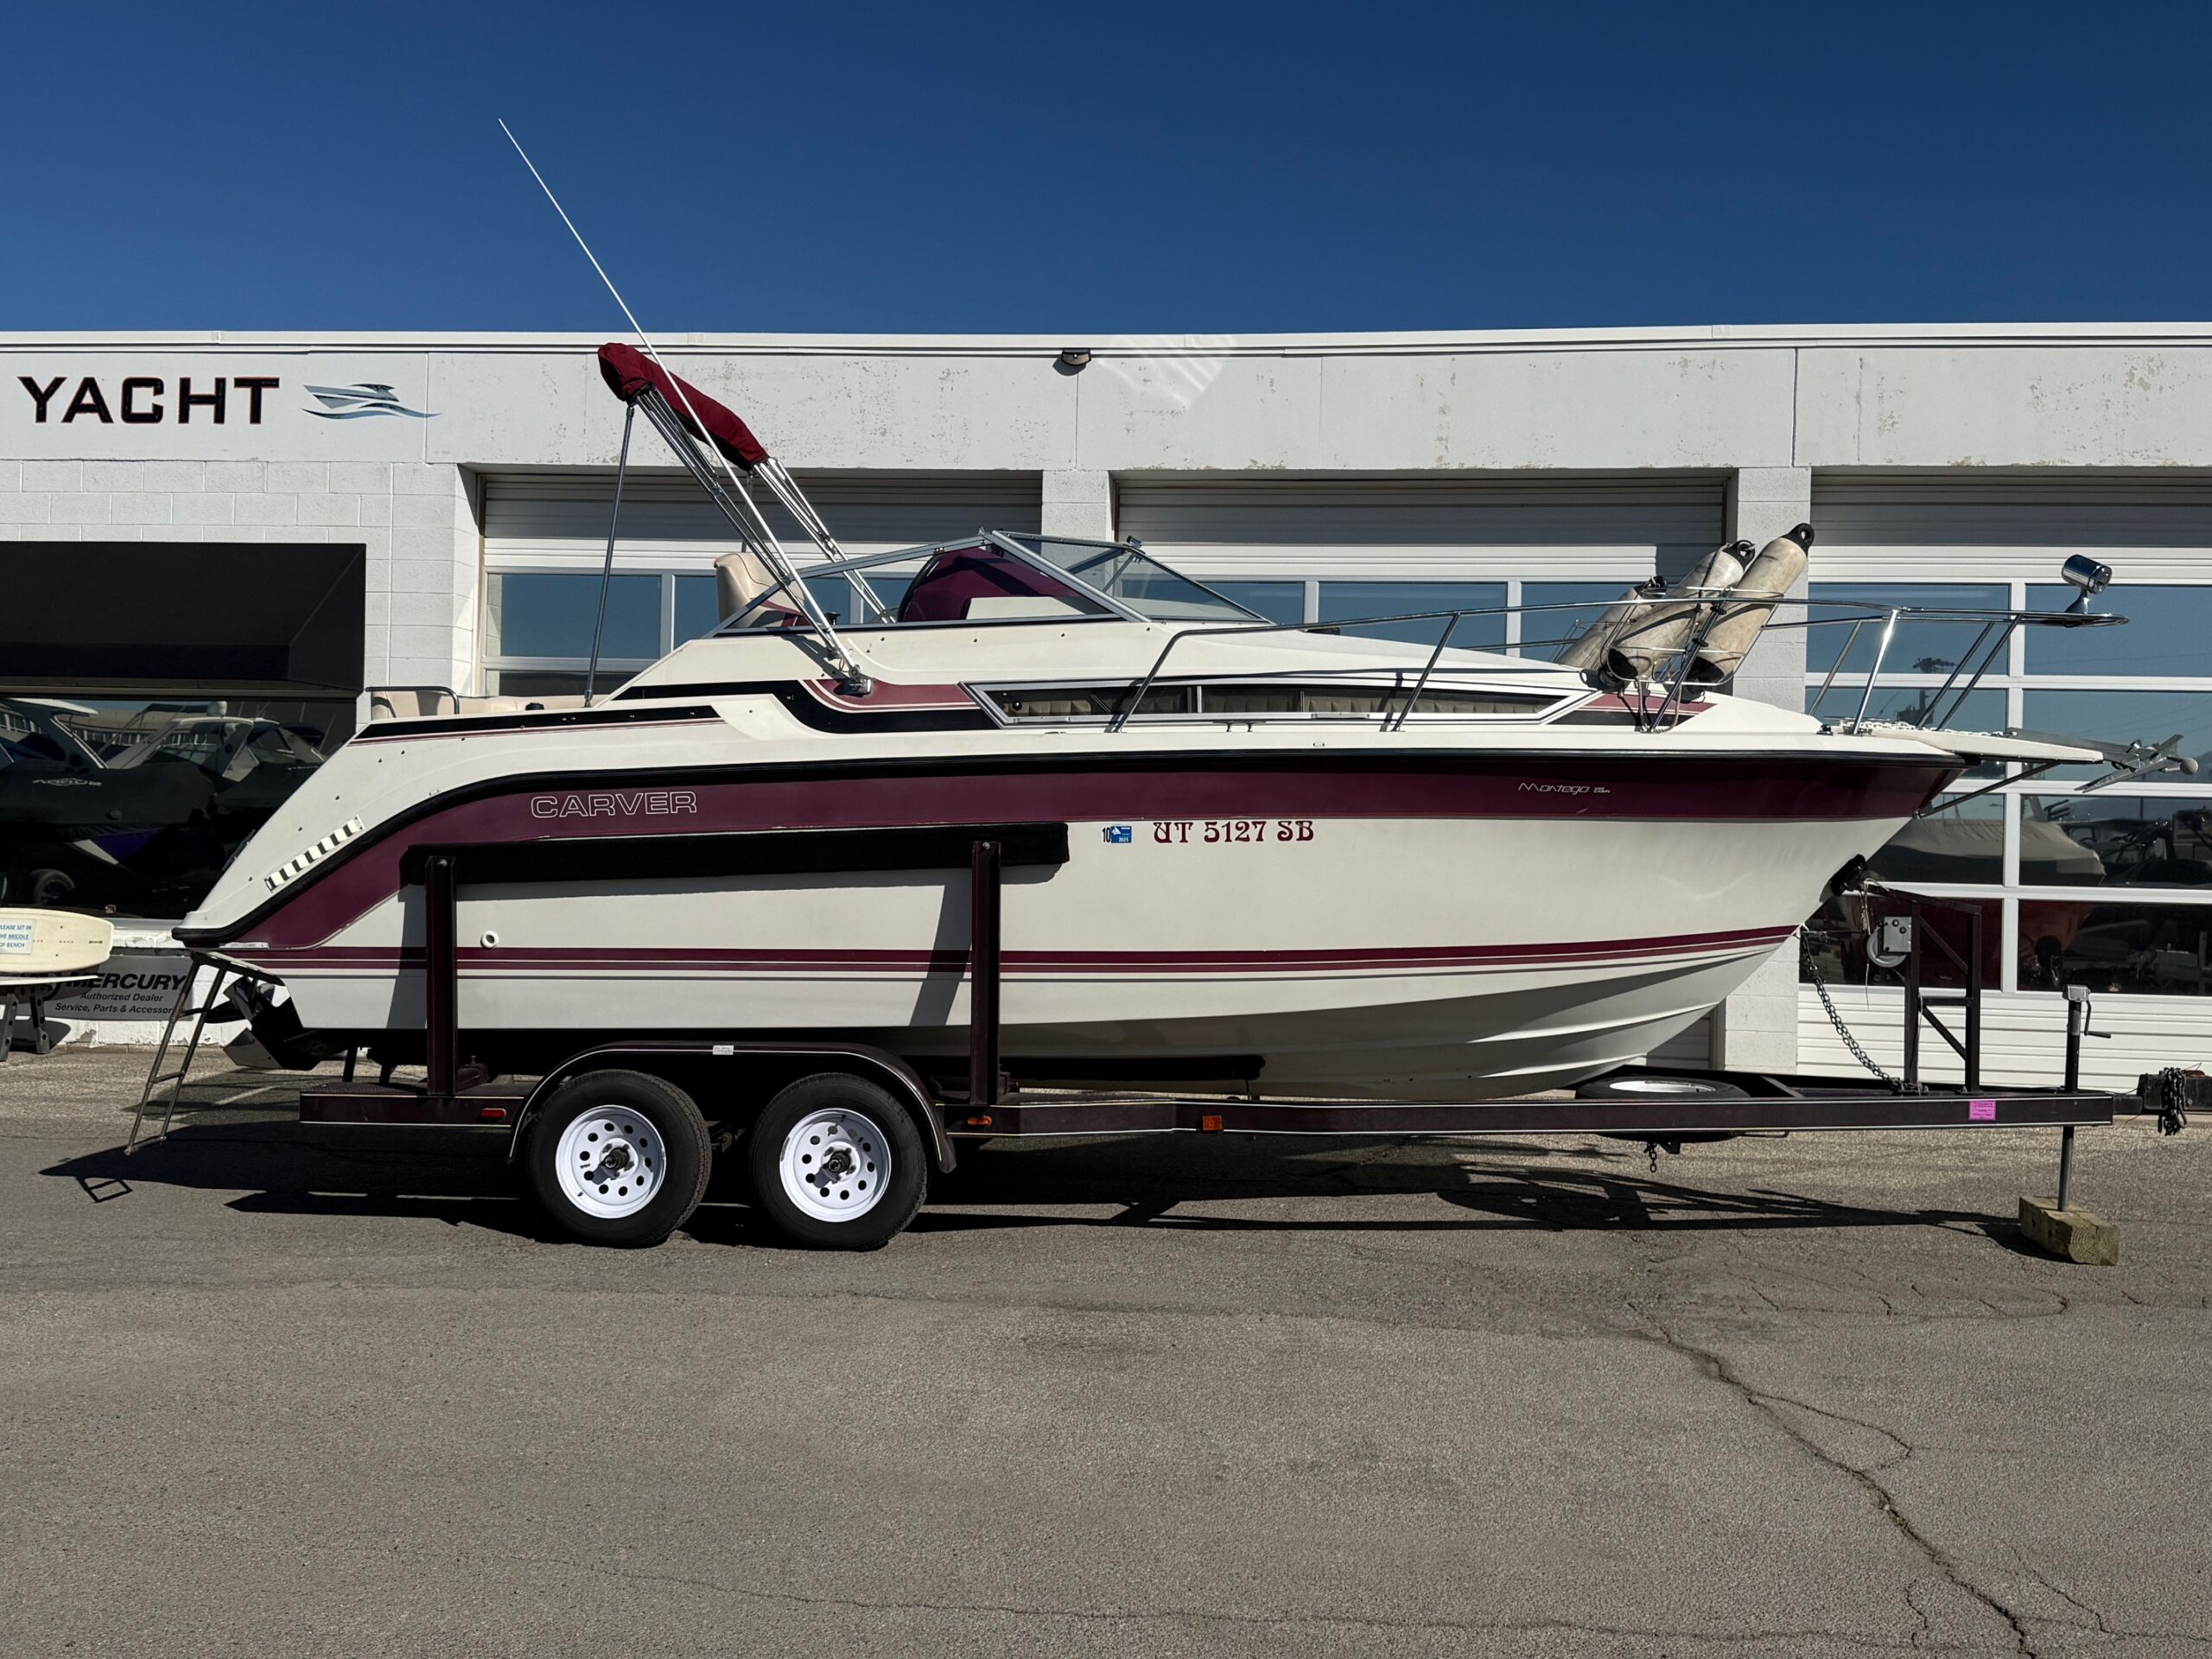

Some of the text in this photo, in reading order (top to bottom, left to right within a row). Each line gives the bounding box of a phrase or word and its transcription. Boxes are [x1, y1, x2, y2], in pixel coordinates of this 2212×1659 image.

[17, 376, 280, 424] YACHT
[1518, 782, 1590, 795] Montego
[531, 791, 697, 818] CARVER
[1102, 827, 1111, 842] 10
[1153, 820, 1314, 843] UT 5127 SB
[66, 973, 188, 990] MERCURY
[80, 993, 164, 1002] Authorized Dealer
[55, 1002, 91, 1013] Service,
[92, 1004, 118, 1013] Parts
[129, 1005, 173, 1014] Accessor
